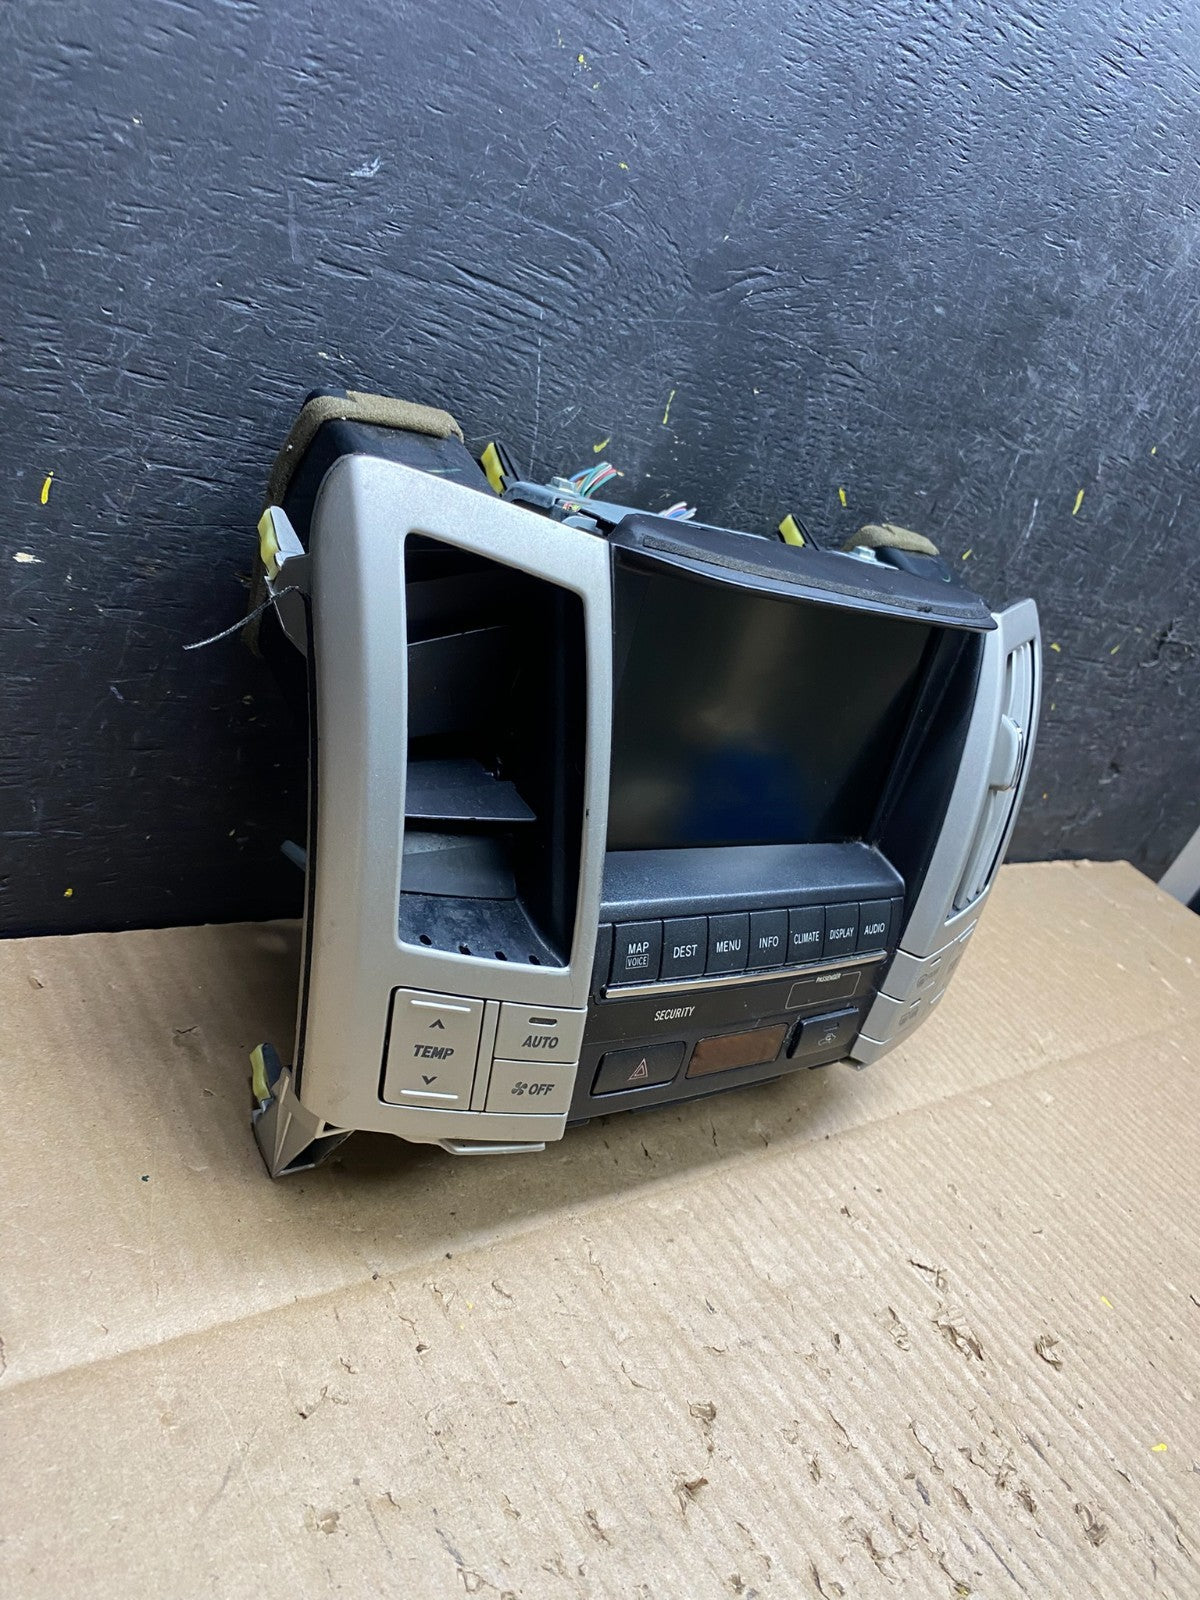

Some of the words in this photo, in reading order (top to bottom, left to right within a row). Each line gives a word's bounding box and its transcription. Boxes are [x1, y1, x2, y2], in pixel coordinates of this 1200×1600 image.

[829, 927, 854, 940] DISPLAY
[864, 922, 884, 935] AUDIO
[759, 936, 779, 949] INFO
[794, 931, 819, 945] CLIMATE
[628, 942, 649, 955] MAP
[673, 944, 698, 959] DEST
[716, 939, 741, 953] MENU
[627, 956, 648, 967] VOICE
[654, 1006, 695, 1021] SECURITY
[522, 1036, 559, 1049] AUTO
[413, 1044, 454, 1060] TEMP
[528, 1084, 555, 1096] OFF
